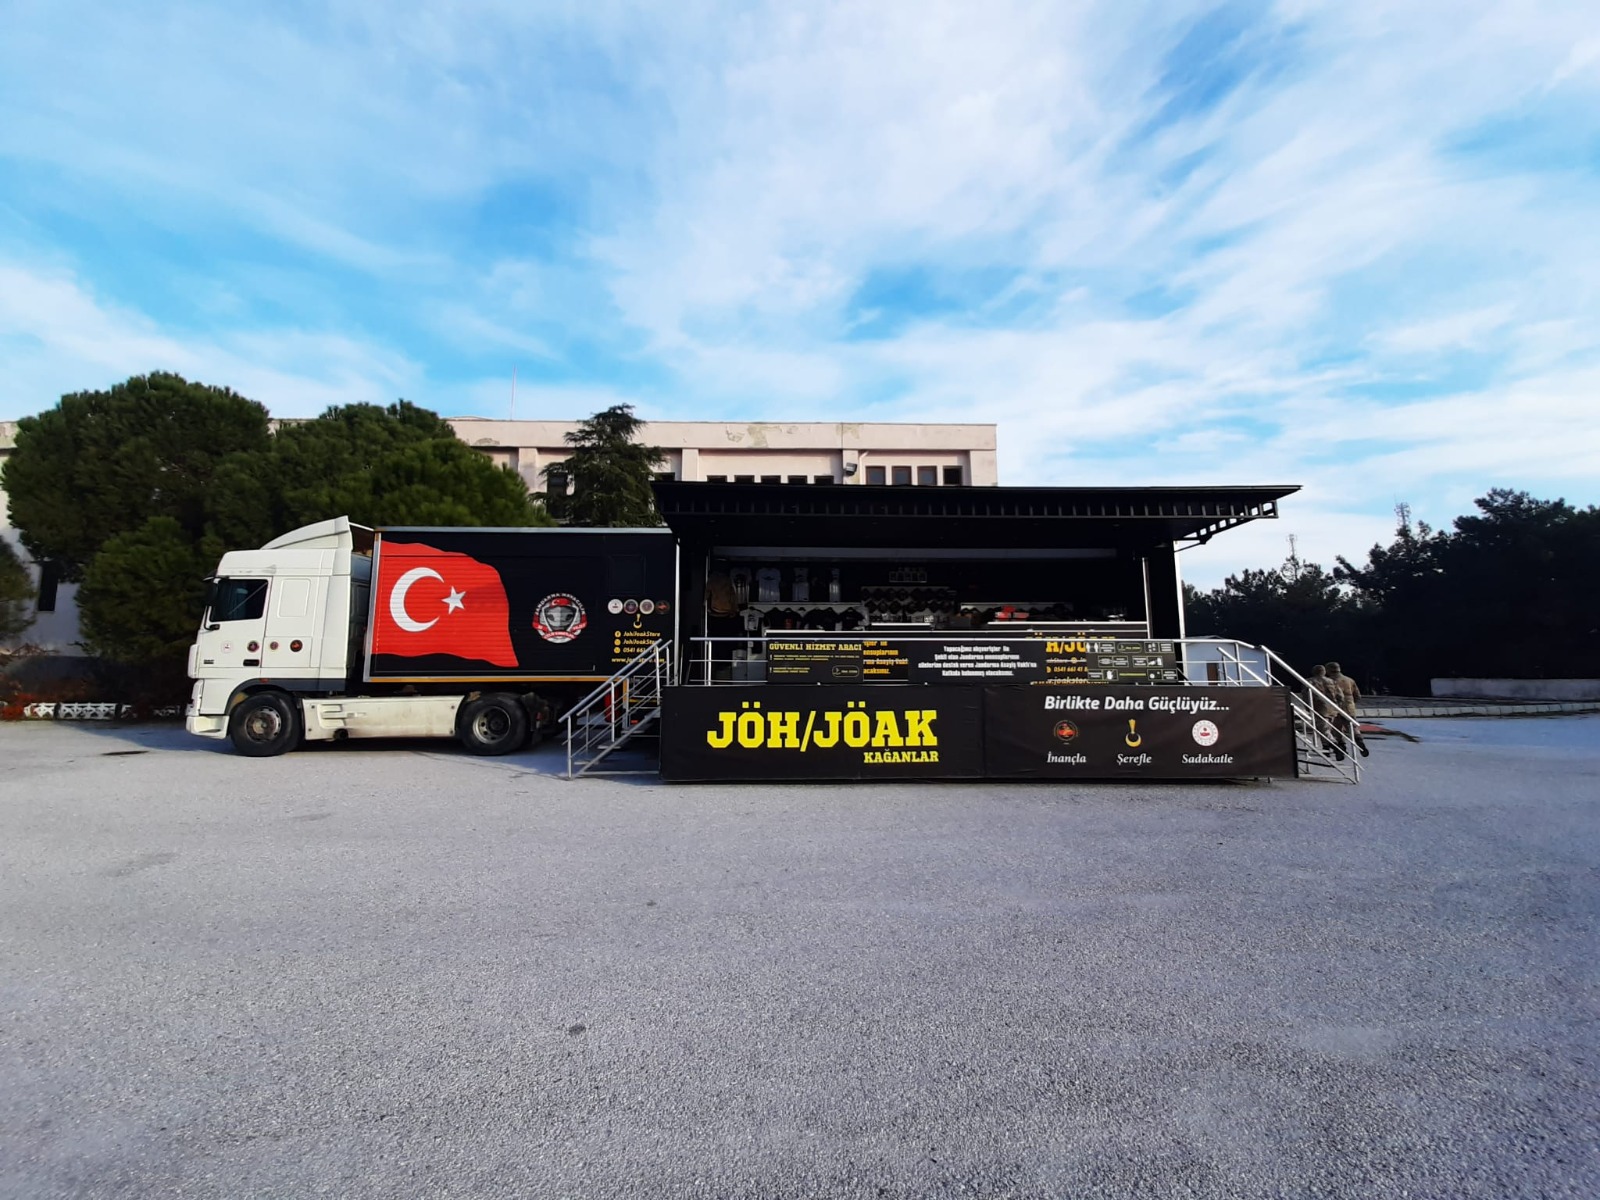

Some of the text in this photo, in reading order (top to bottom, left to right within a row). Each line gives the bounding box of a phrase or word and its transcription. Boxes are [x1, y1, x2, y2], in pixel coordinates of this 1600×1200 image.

[769, 642, 862, 651] GÜVENLİ HİZMET ARACI
[1044, 695, 1100, 710] Birlikte
[1104, 696, 1144, 710] Daha
[706, 701, 938, 752] JÖH/JÖAK
[863, 748, 939, 763] KAĞANLAR
[1046, 751, 1087, 765] İnançla
[1116, 753, 1152, 766] Şerefle
[1182, 753, 1233, 764] Sadakatle
